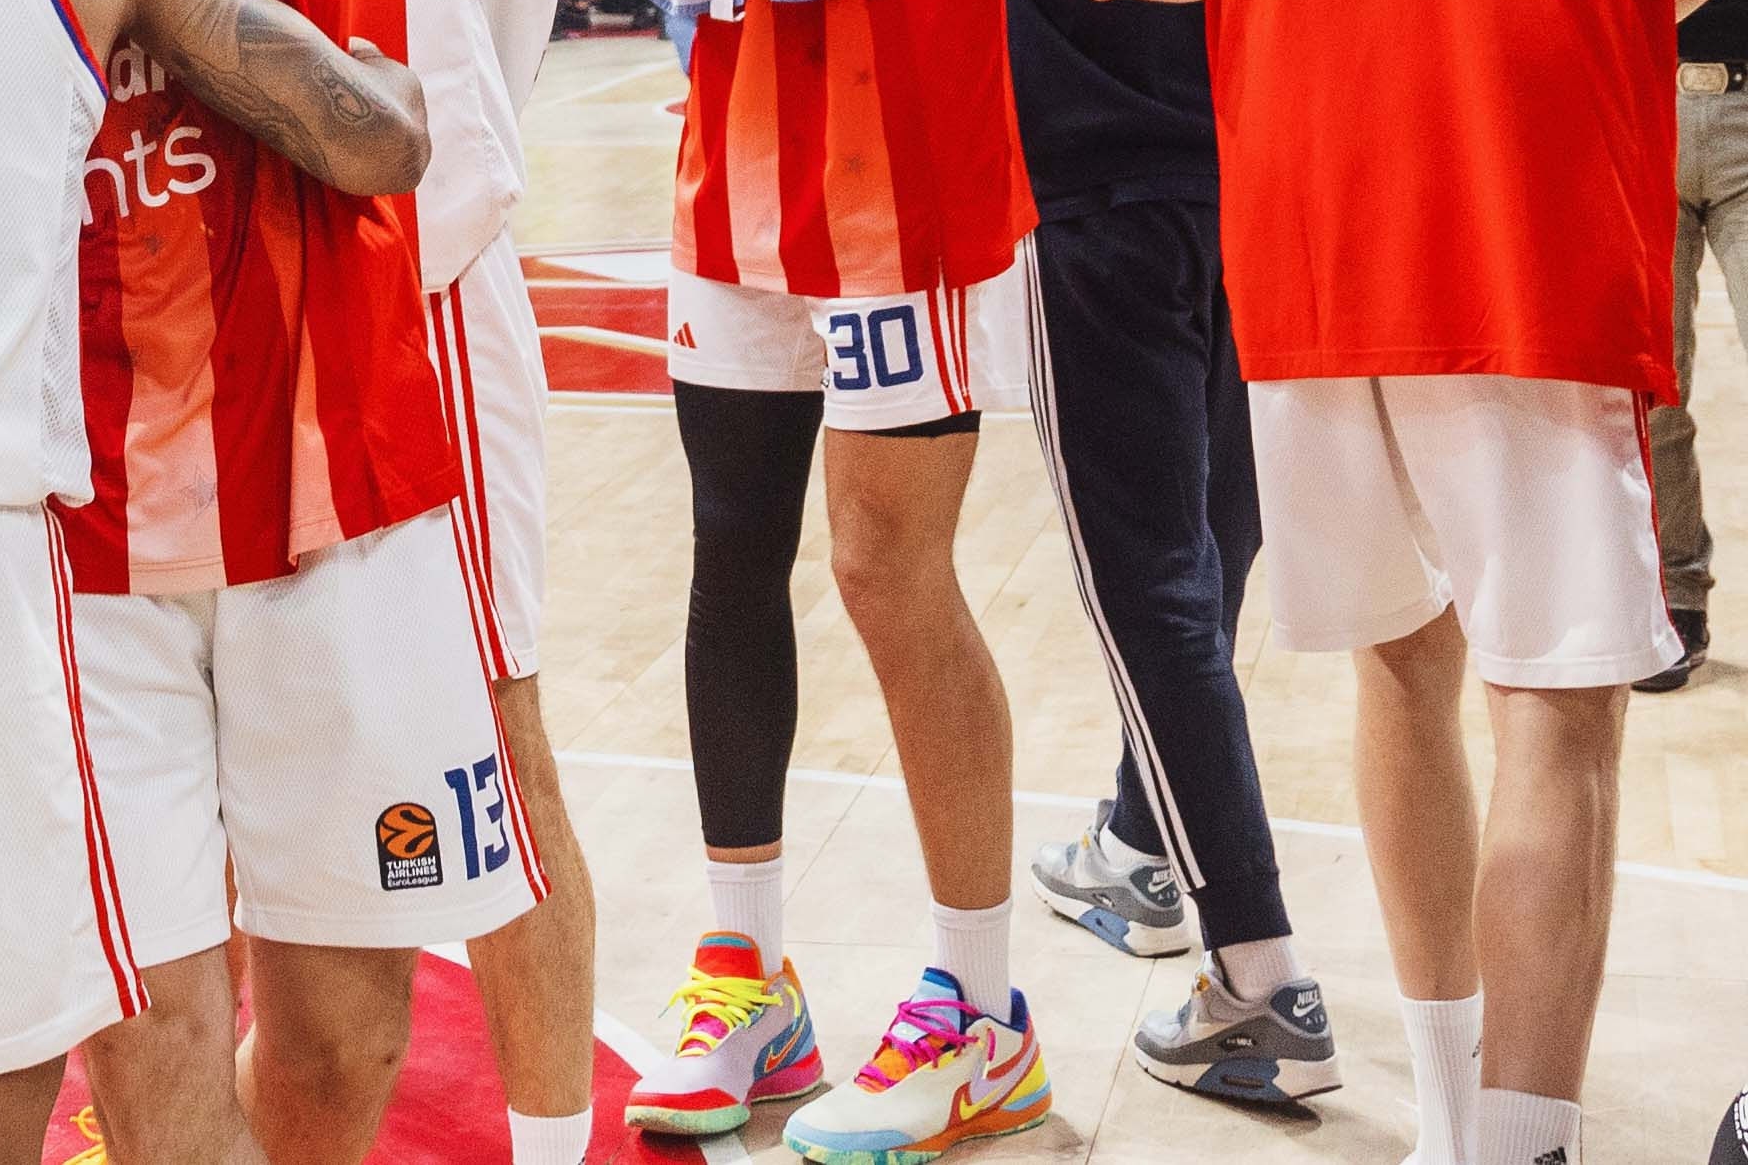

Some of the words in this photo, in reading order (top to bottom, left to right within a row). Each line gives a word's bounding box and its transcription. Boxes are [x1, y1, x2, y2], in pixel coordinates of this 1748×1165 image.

[829, 304, 924, 391] 30
[443, 752, 511, 881] 13
[386, 855, 436, 870] TURKISH
[387, 865, 438, 880] AIRLINES
